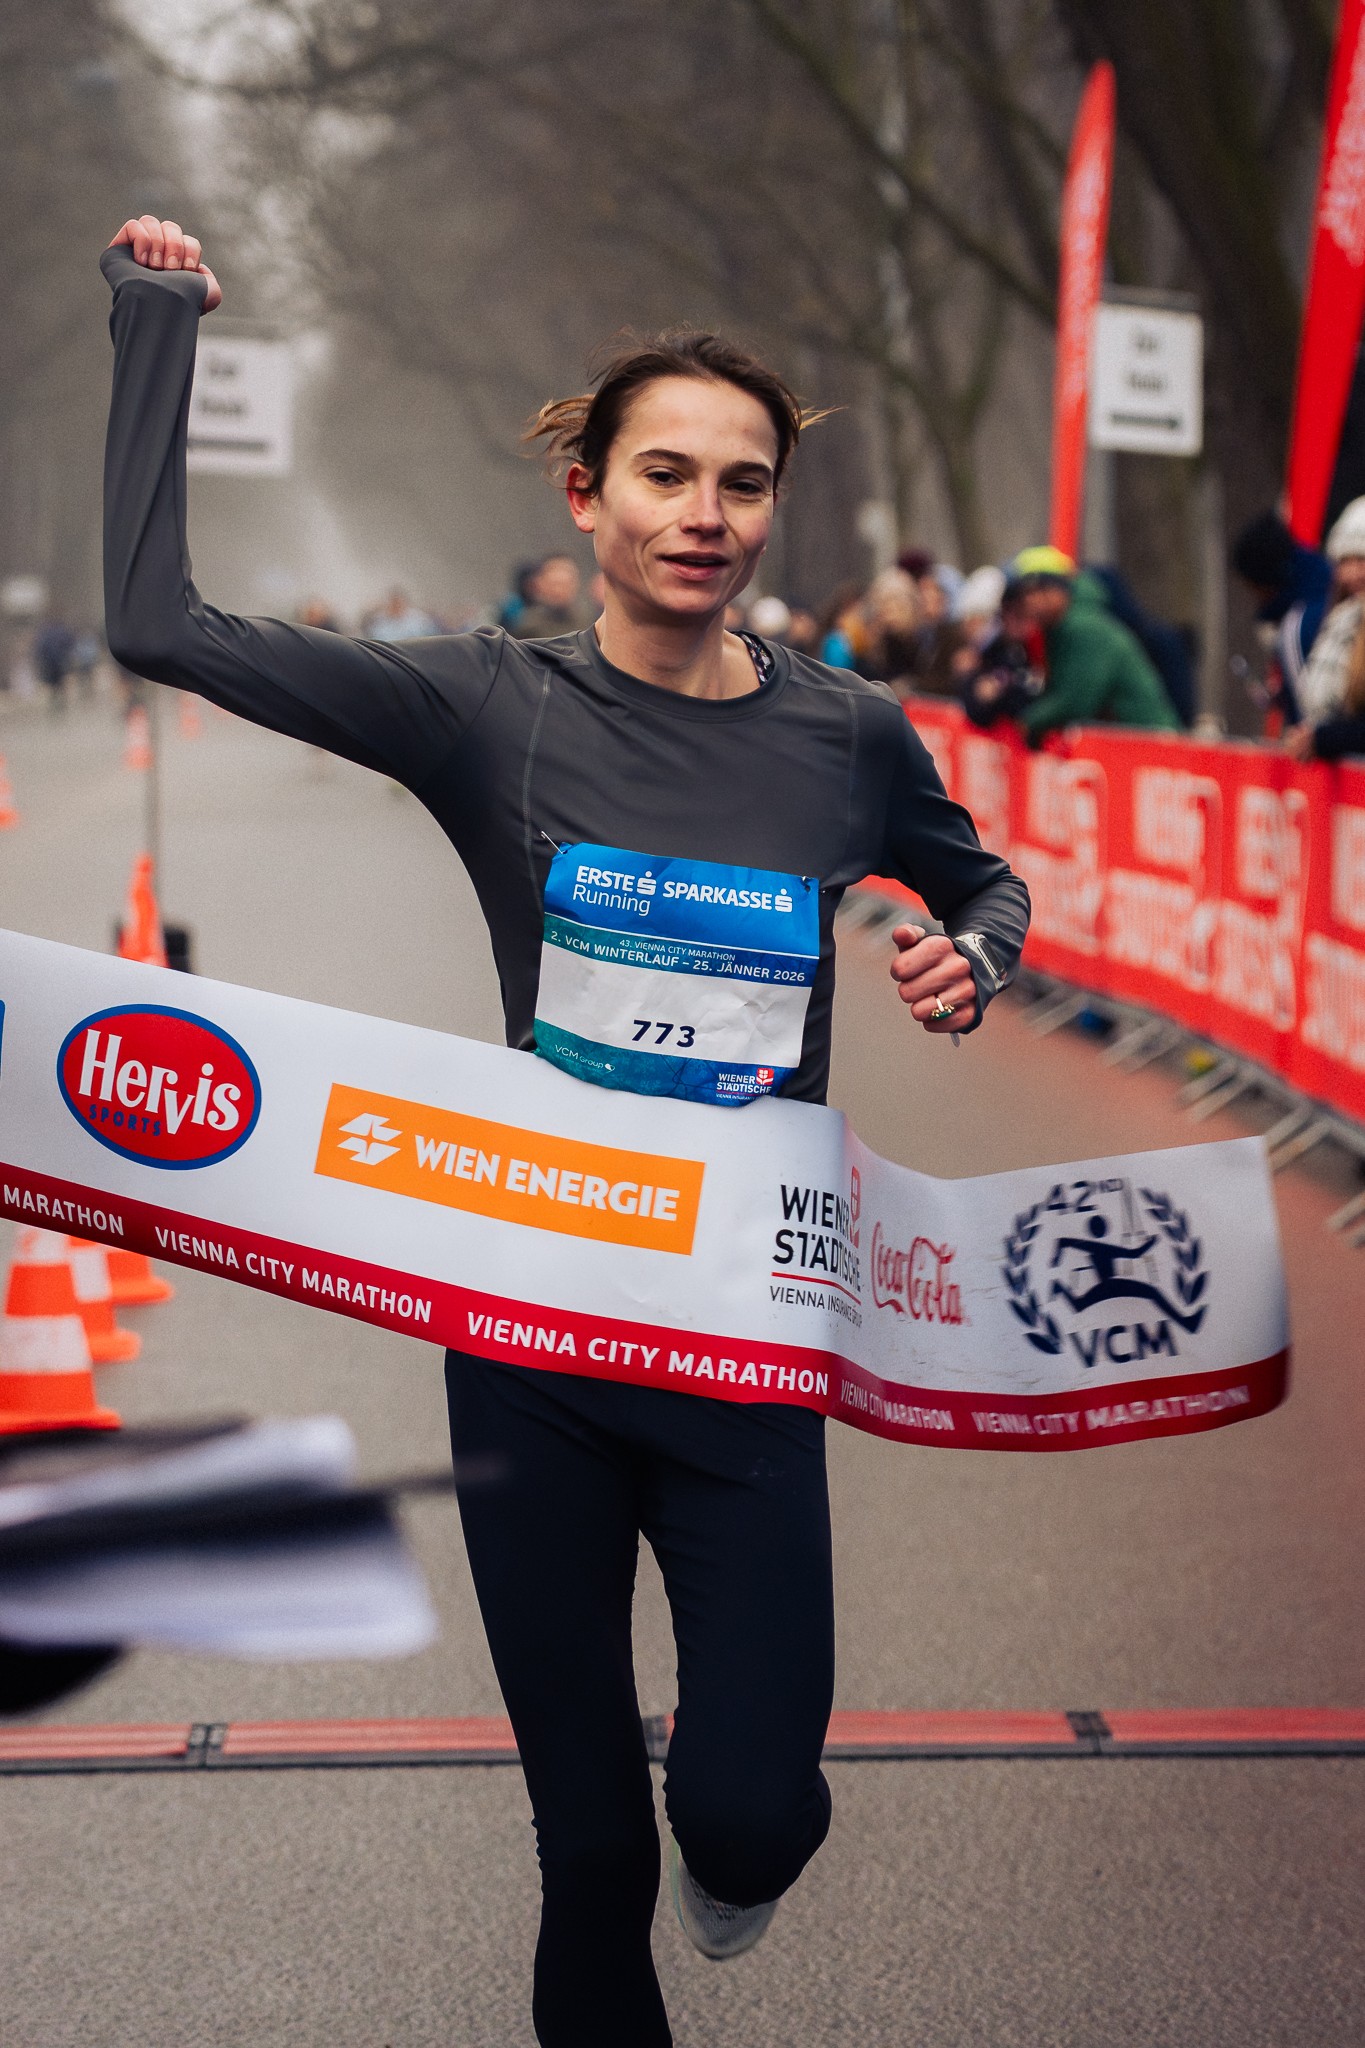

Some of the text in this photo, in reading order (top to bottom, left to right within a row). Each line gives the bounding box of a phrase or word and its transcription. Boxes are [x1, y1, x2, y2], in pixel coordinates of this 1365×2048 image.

[572, 884, 650, 917] Running
[576, 865, 772, 910] ERSTE SPARKASSE
[551, 930, 561, 942] 2.
[565, 935, 590, 953] VCM
[594, 943, 680, 967] WINTERLAUF
[692, 959, 713, 972] 25.
[716, 961, 770, 979] JÄNNER
[773, 969, 805, 982] 2026
[619, 939, 736, 962] 43. VIENNA CITY MARATHON
[554, 1044, 579, 1060] VCM
[632, 1019, 696, 1047] 773
[78, 1028, 242, 1136] Hervis
[718, 1073, 756, 1085] WIENER
[89, 1103, 162, 1137] SPORTS
[414, 1134, 681, 1222] WIEN ENERGIE
[3, 1184, 124, 1236] MARATHON
[780, 1184, 850, 1241] WIENER
[155, 1226, 432, 1323] VIENNA CITY MARATHON
[772, 1228, 861, 1293] STÄDTISCHE
[769, 1285, 826, 1311] VIENNA
[467, 1311, 829, 1396] VIENNA CITY MARATHON
[1067, 1319, 1180, 1369] VCM
[840, 1379, 868, 1412] VIENNA
[883, 1400, 955, 1431] MARATHON
[1032, 1411, 1081, 1435] CITY
[1083, 1385, 1250, 1430] MARATHON
